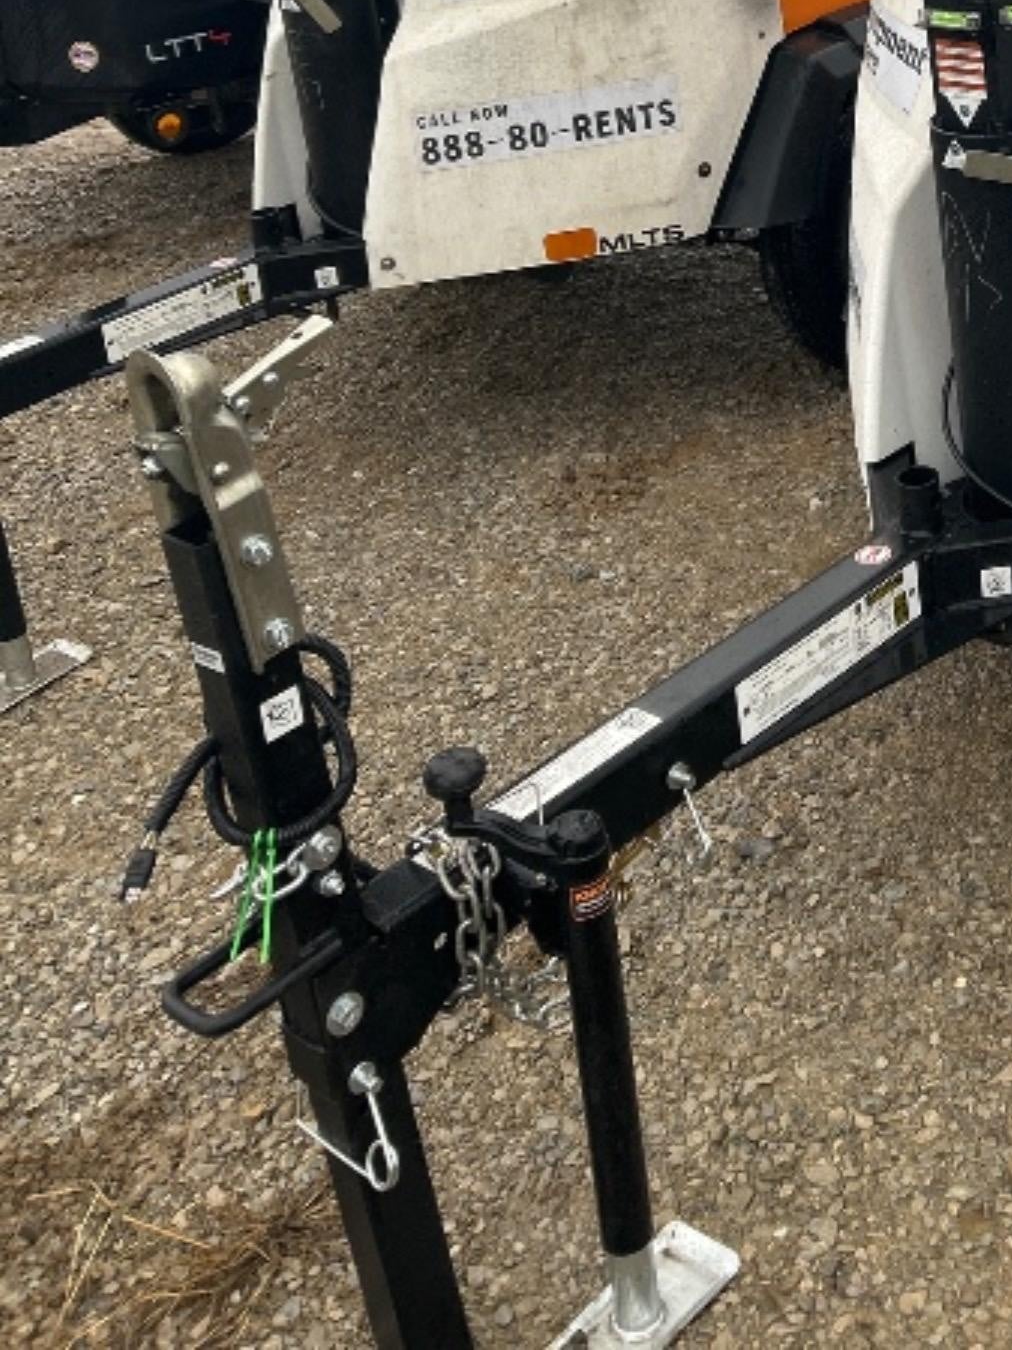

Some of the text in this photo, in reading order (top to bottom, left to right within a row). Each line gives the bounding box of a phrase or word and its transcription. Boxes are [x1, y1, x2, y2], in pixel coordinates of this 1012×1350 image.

[416, 103, 509, 130] CALL NOW
[421, 98, 677, 167] 888-80-RENTS
